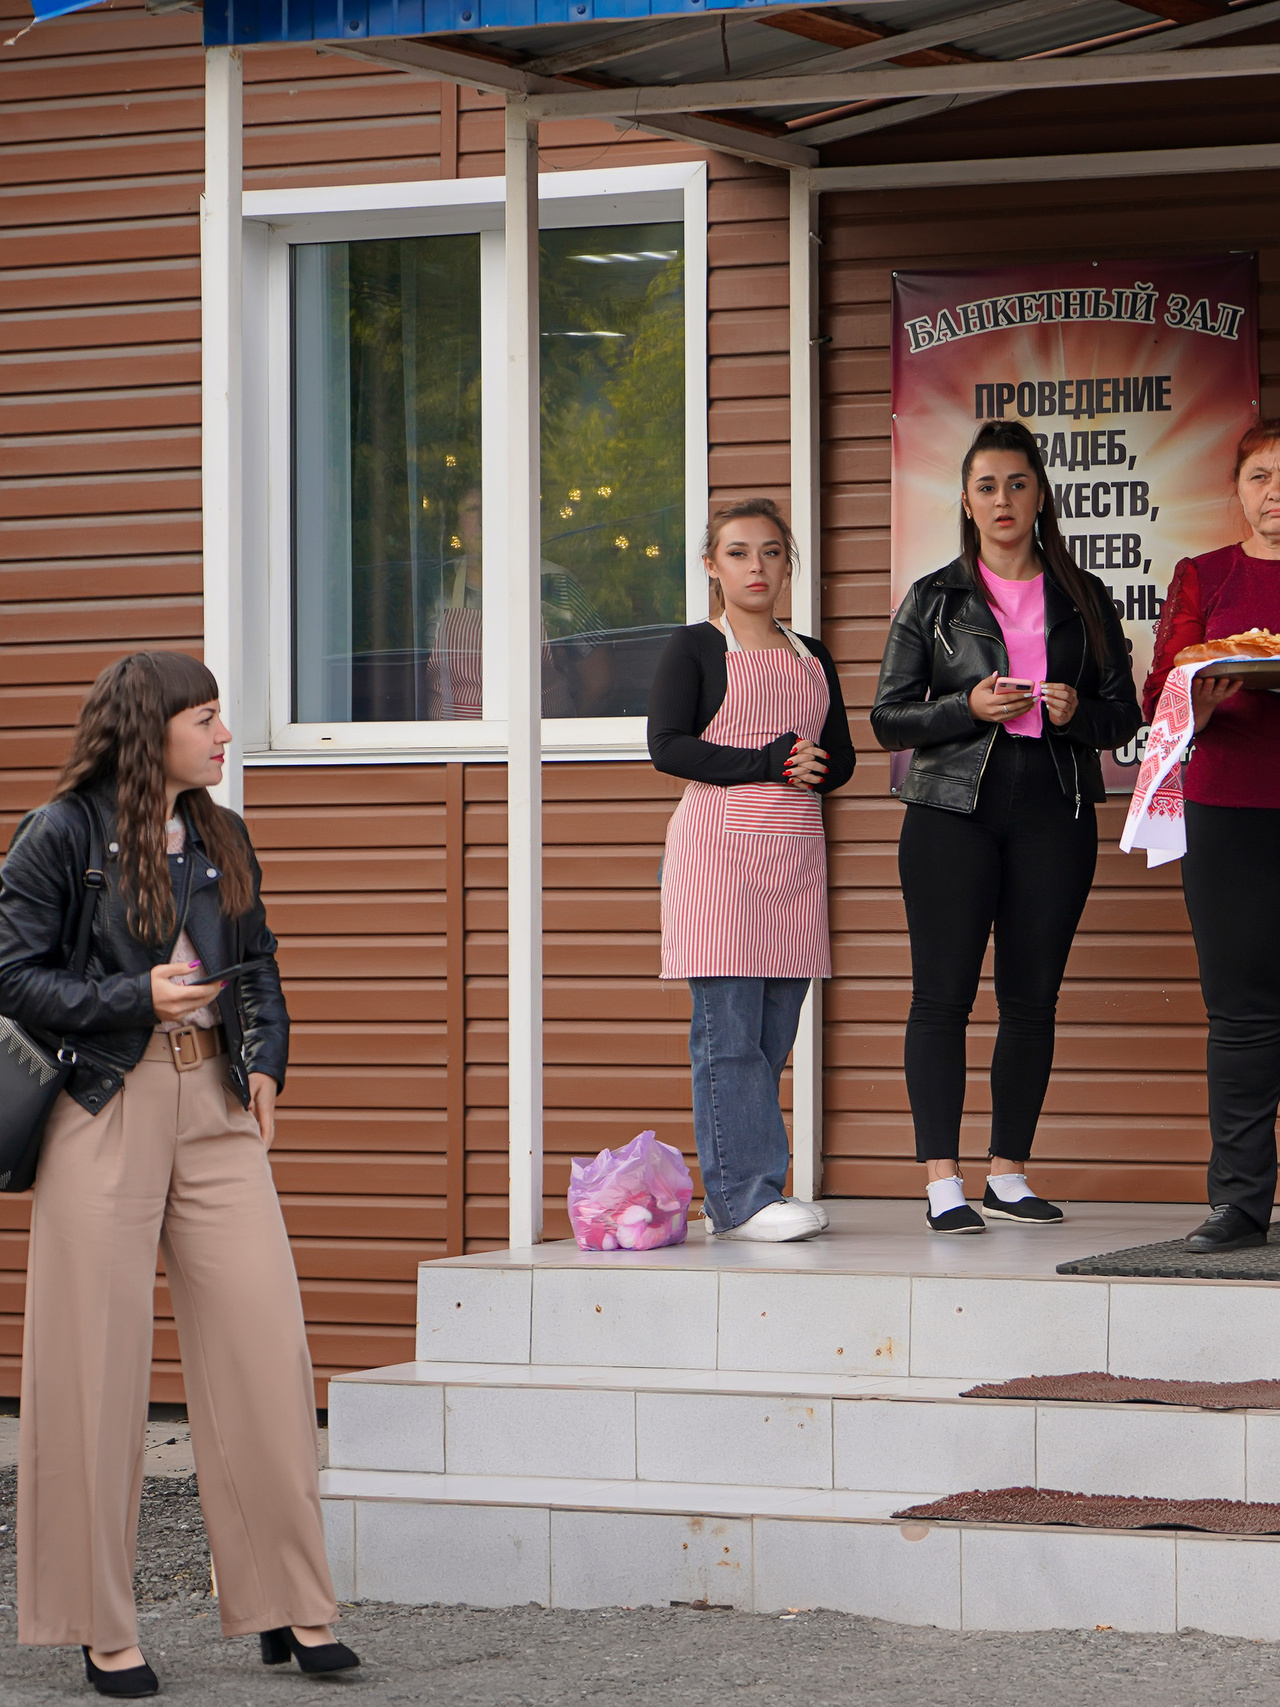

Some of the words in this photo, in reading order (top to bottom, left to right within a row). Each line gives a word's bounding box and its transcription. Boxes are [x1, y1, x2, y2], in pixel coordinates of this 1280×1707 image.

[904, 281, 1158, 353] БАНКЕТНЫЙ
[1164, 293, 1245, 340] ЗАЛ
[975, 375, 1172, 420] ПРОВЕДЕНИЕ
[1032, 429, 1137, 472] ВАДЕБ,
